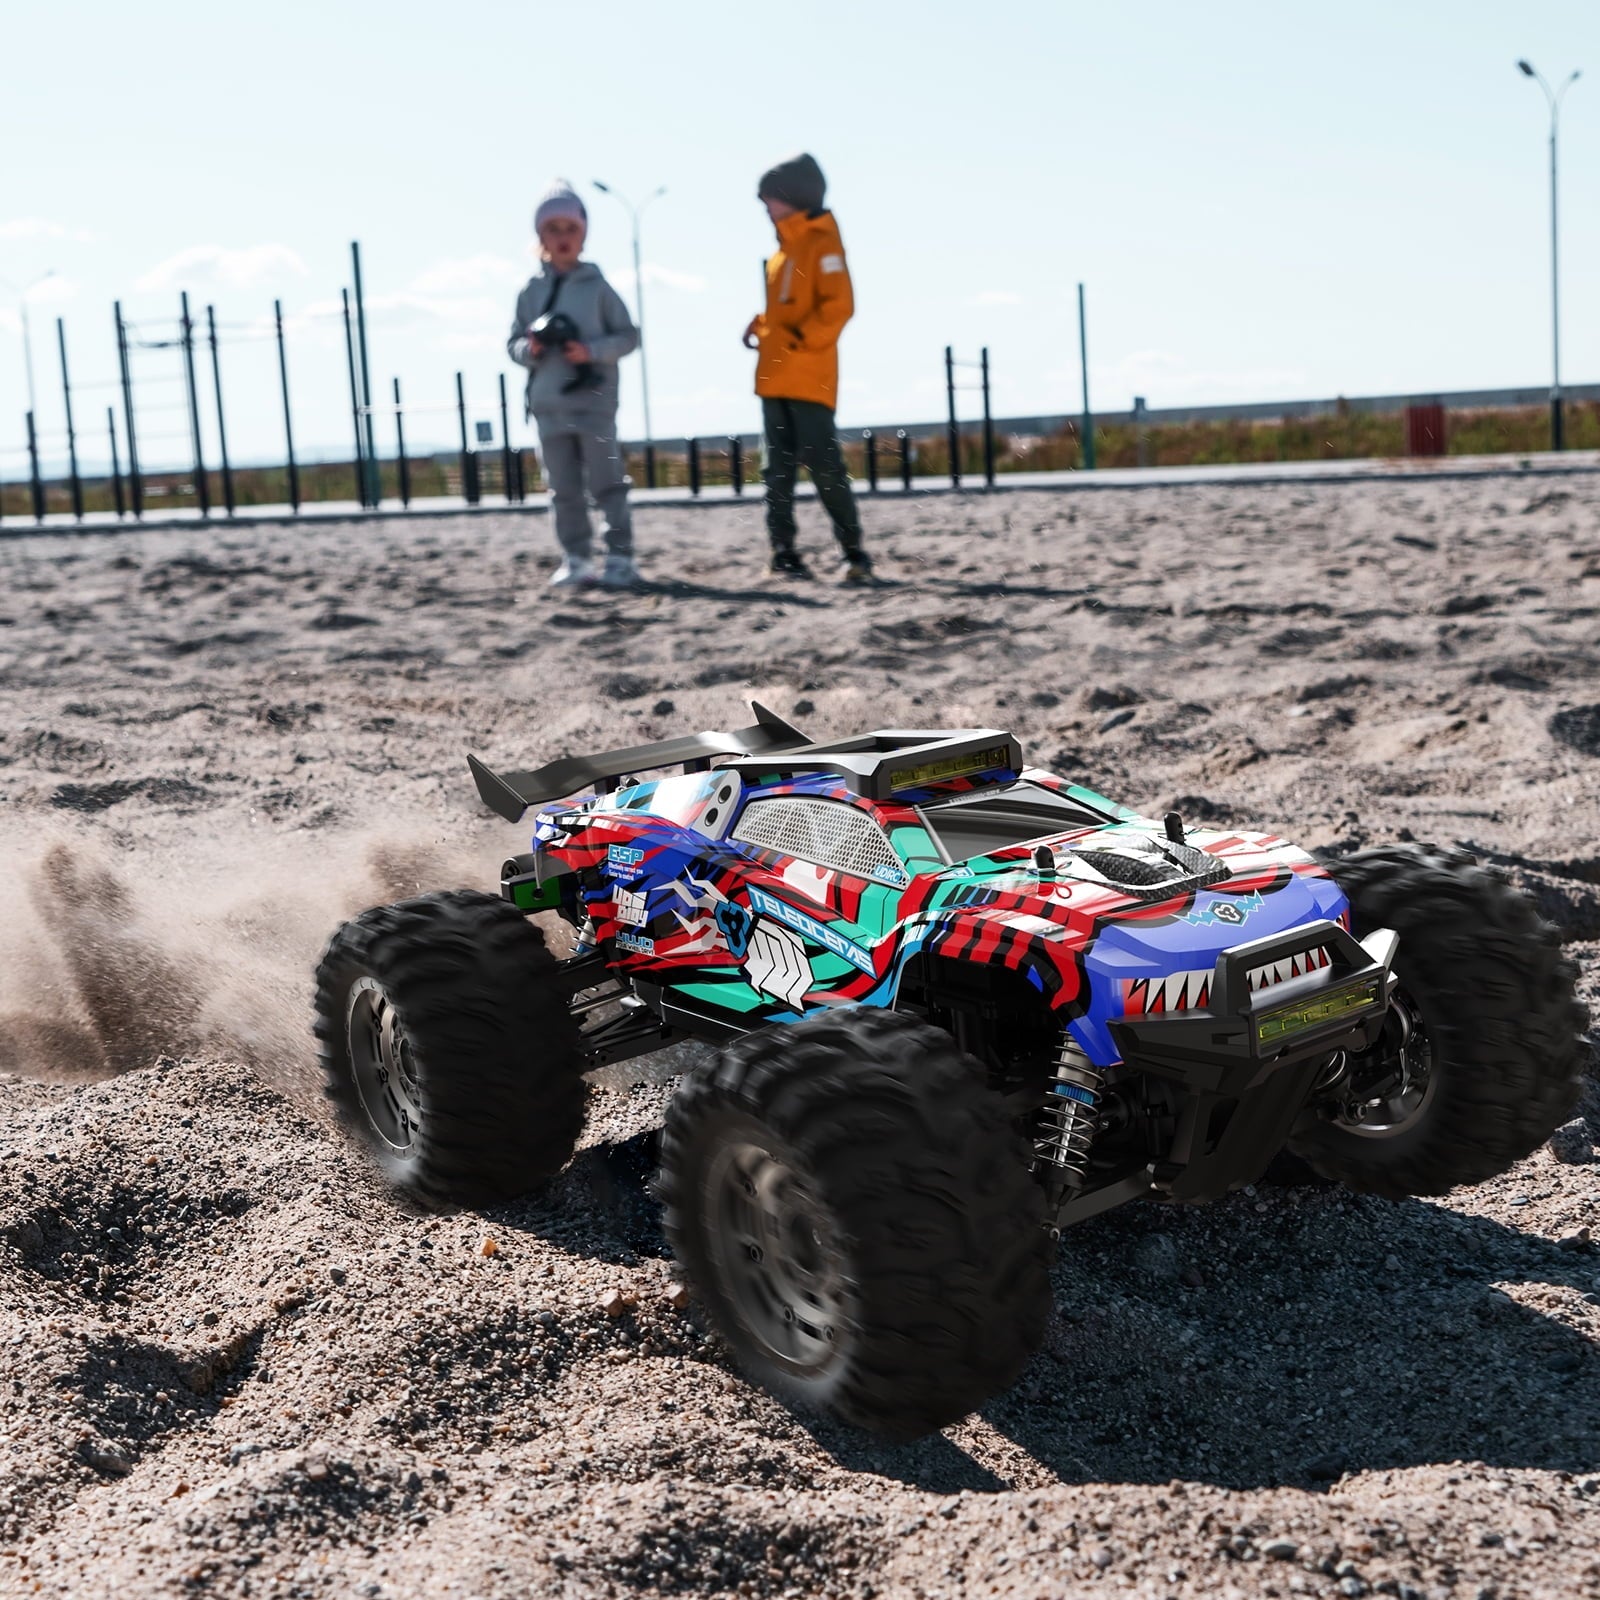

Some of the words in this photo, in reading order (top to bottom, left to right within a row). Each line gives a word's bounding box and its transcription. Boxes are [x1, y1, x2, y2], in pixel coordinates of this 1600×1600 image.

[608, 844, 644, 865] ESP
[875, 866, 900, 883] UDIRC
[747, 887, 876, 976] TELEOCERAS
